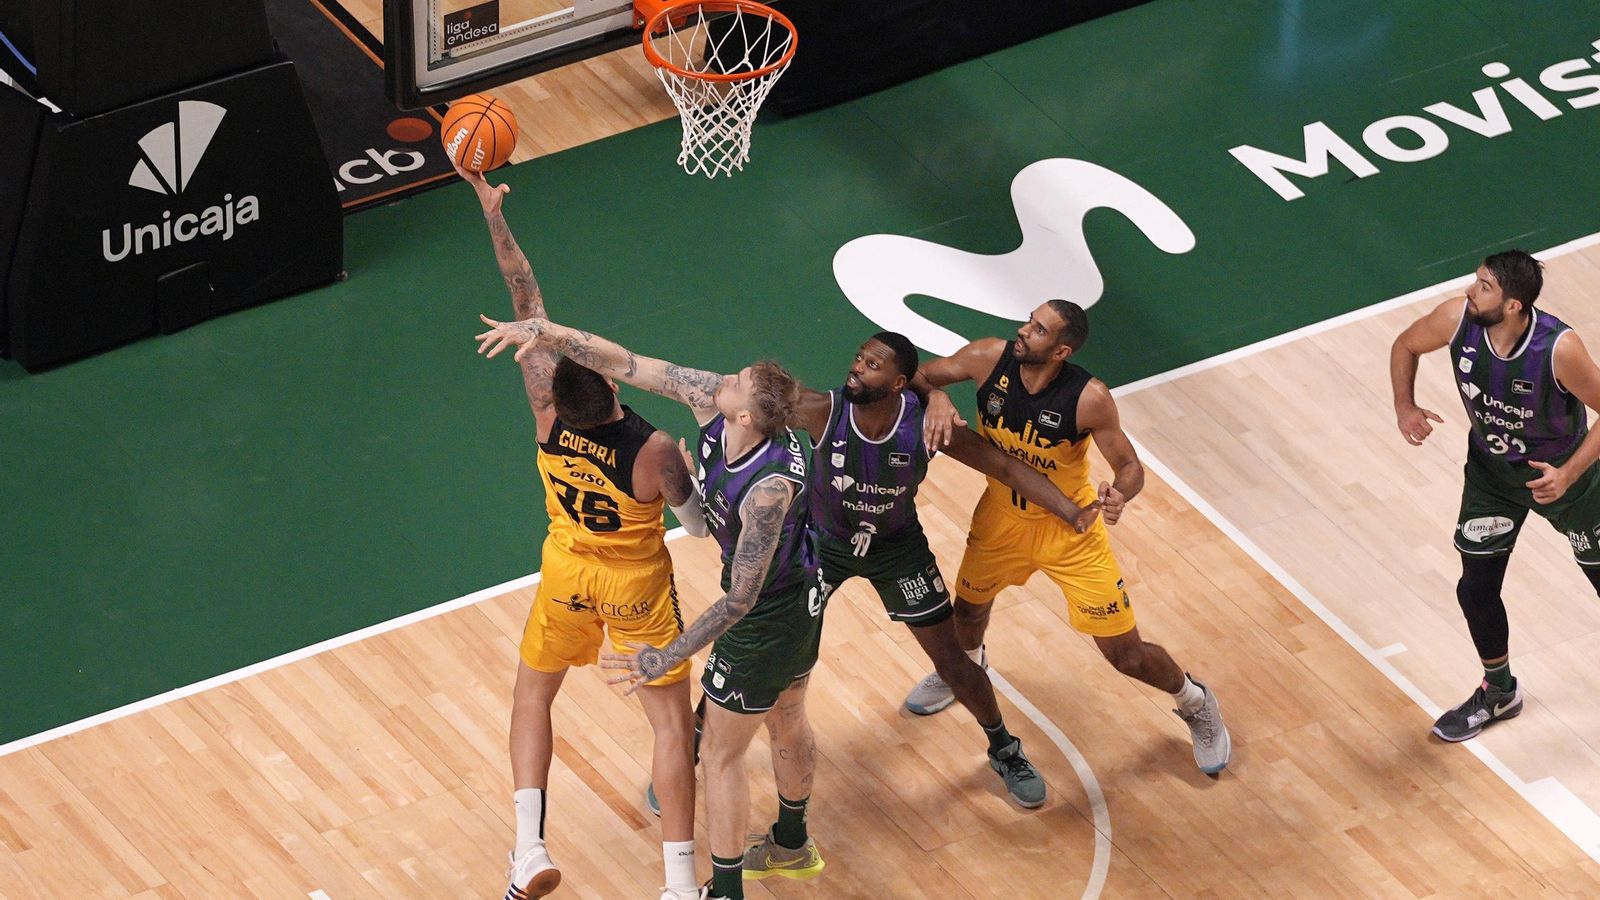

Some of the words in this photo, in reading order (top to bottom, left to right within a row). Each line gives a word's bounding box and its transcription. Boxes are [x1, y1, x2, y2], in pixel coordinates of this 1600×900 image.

[447, 20, 470, 35] liga
[447, 23, 497, 45] endesa
[1227, 38, 1600, 202] Movis
[470, 147, 485, 170] EVO
[102, 193, 260, 262] Unicaja
[1483, 393, 1534, 419] Unicaja
[559, 429, 617, 469] GUERRA
[856, 482, 907, 496] Unicaja
[843, 499, 895, 515] málaga
[903, 572, 927, 591] má
[902, 585, 930, 600] laga
[601, 601, 651, 617] CICAR
